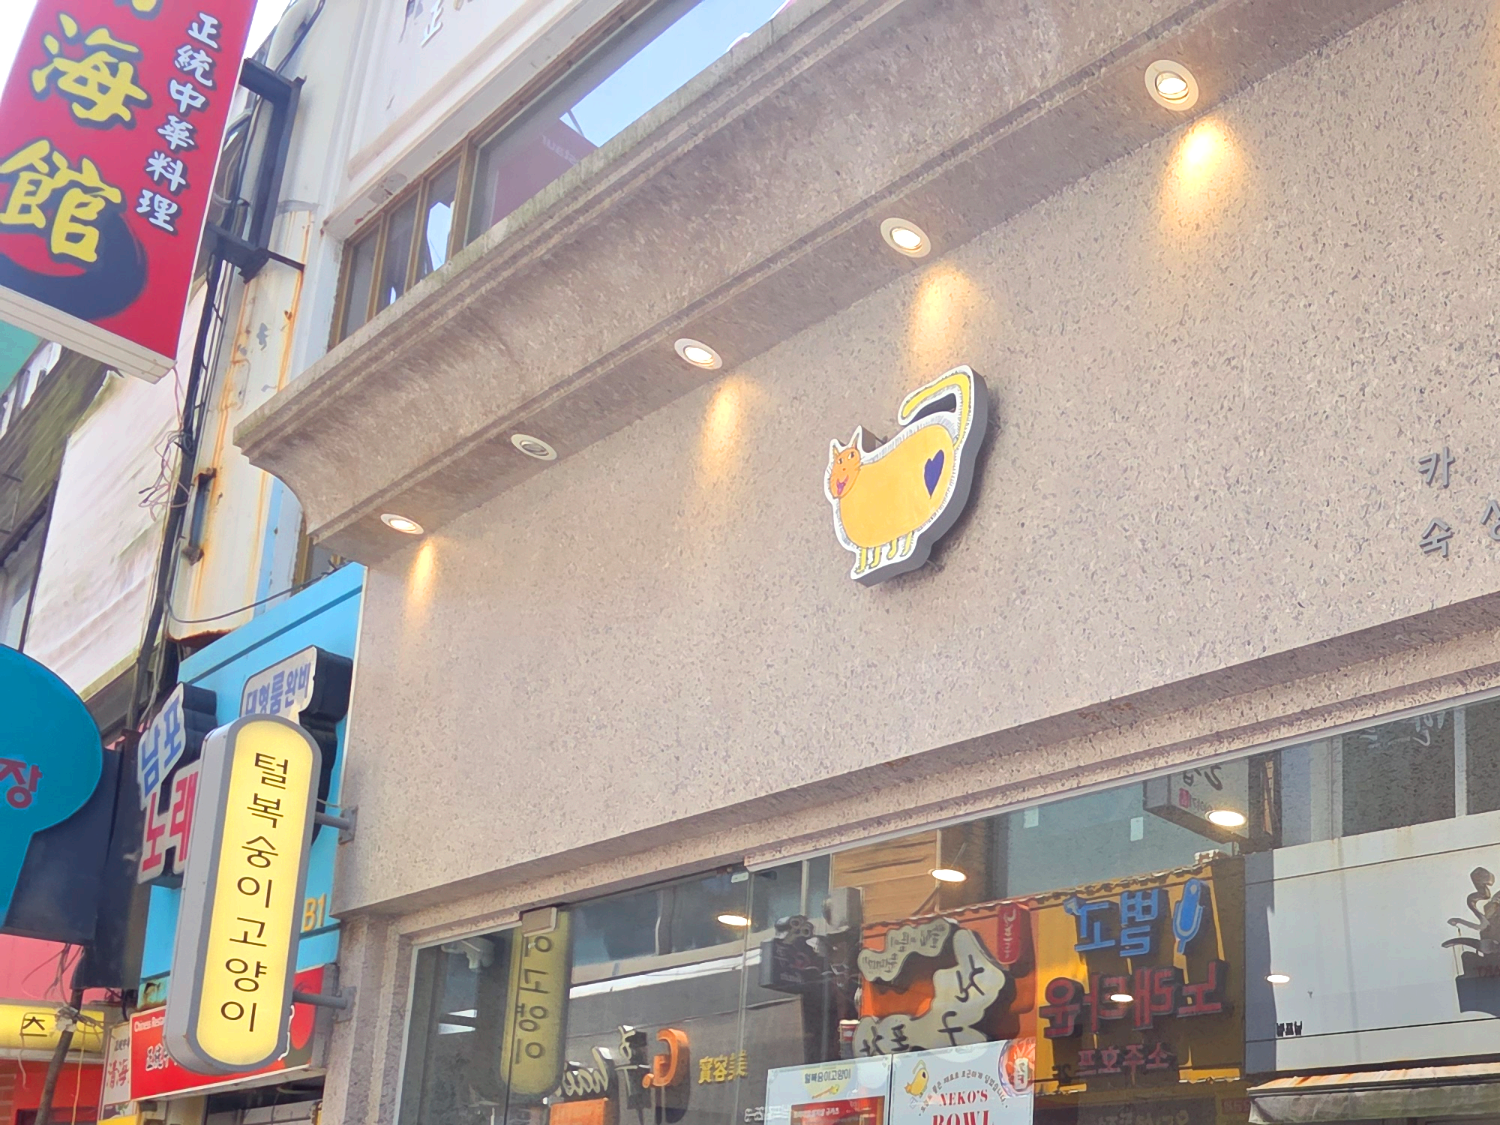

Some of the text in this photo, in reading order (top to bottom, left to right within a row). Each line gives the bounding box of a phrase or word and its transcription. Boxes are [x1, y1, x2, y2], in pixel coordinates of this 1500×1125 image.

[0, 0, 157, 263] 海館
[134, 12, 222, 233] 正統中華料理
[141, 694, 182, 799] 남포
[220, 752, 291, 1033] 털복숭이고양이
[939, 1089, 988, 1106] NEKO'S
